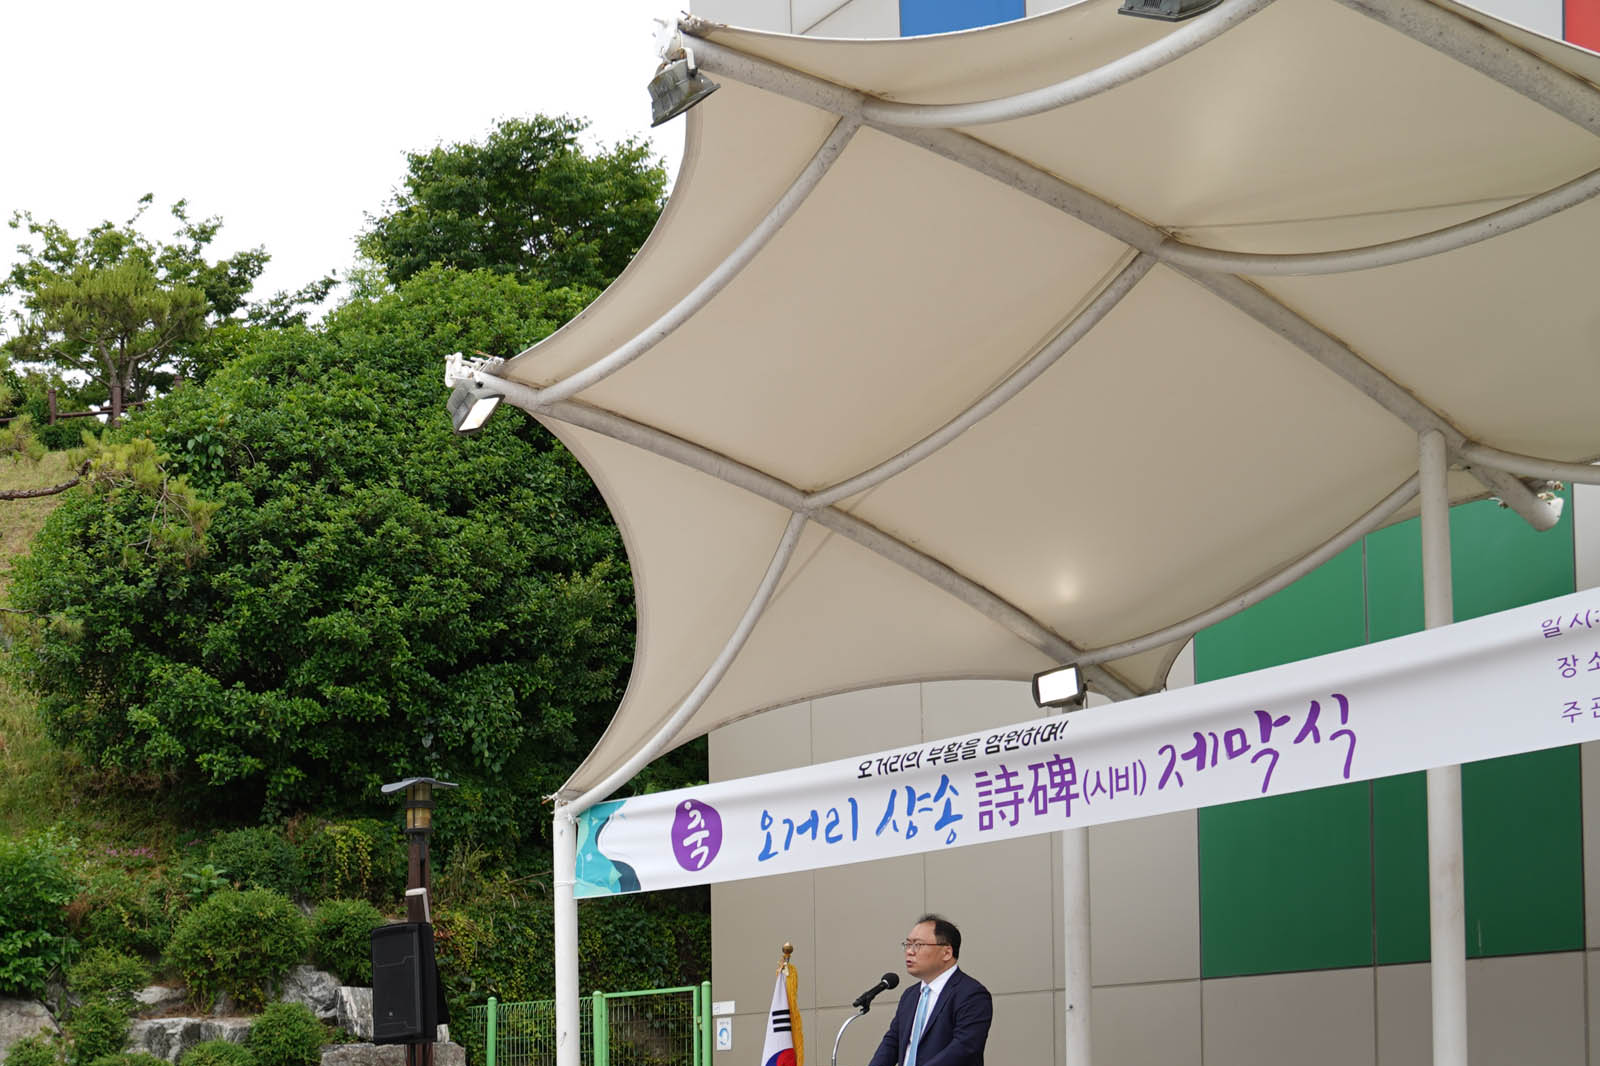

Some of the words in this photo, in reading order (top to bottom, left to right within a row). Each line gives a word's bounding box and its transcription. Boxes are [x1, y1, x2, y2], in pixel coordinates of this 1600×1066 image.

[757, 797, 859, 862] 오거리
[974, 753, 1147, 832] 詩碑(시비)
[1157, 693, 1357, 794] 제막식
[857, 748, 924, 779] 오거리의
[926, 738, 981, 766] 부활을
[682, 800, 710, 870] 축
